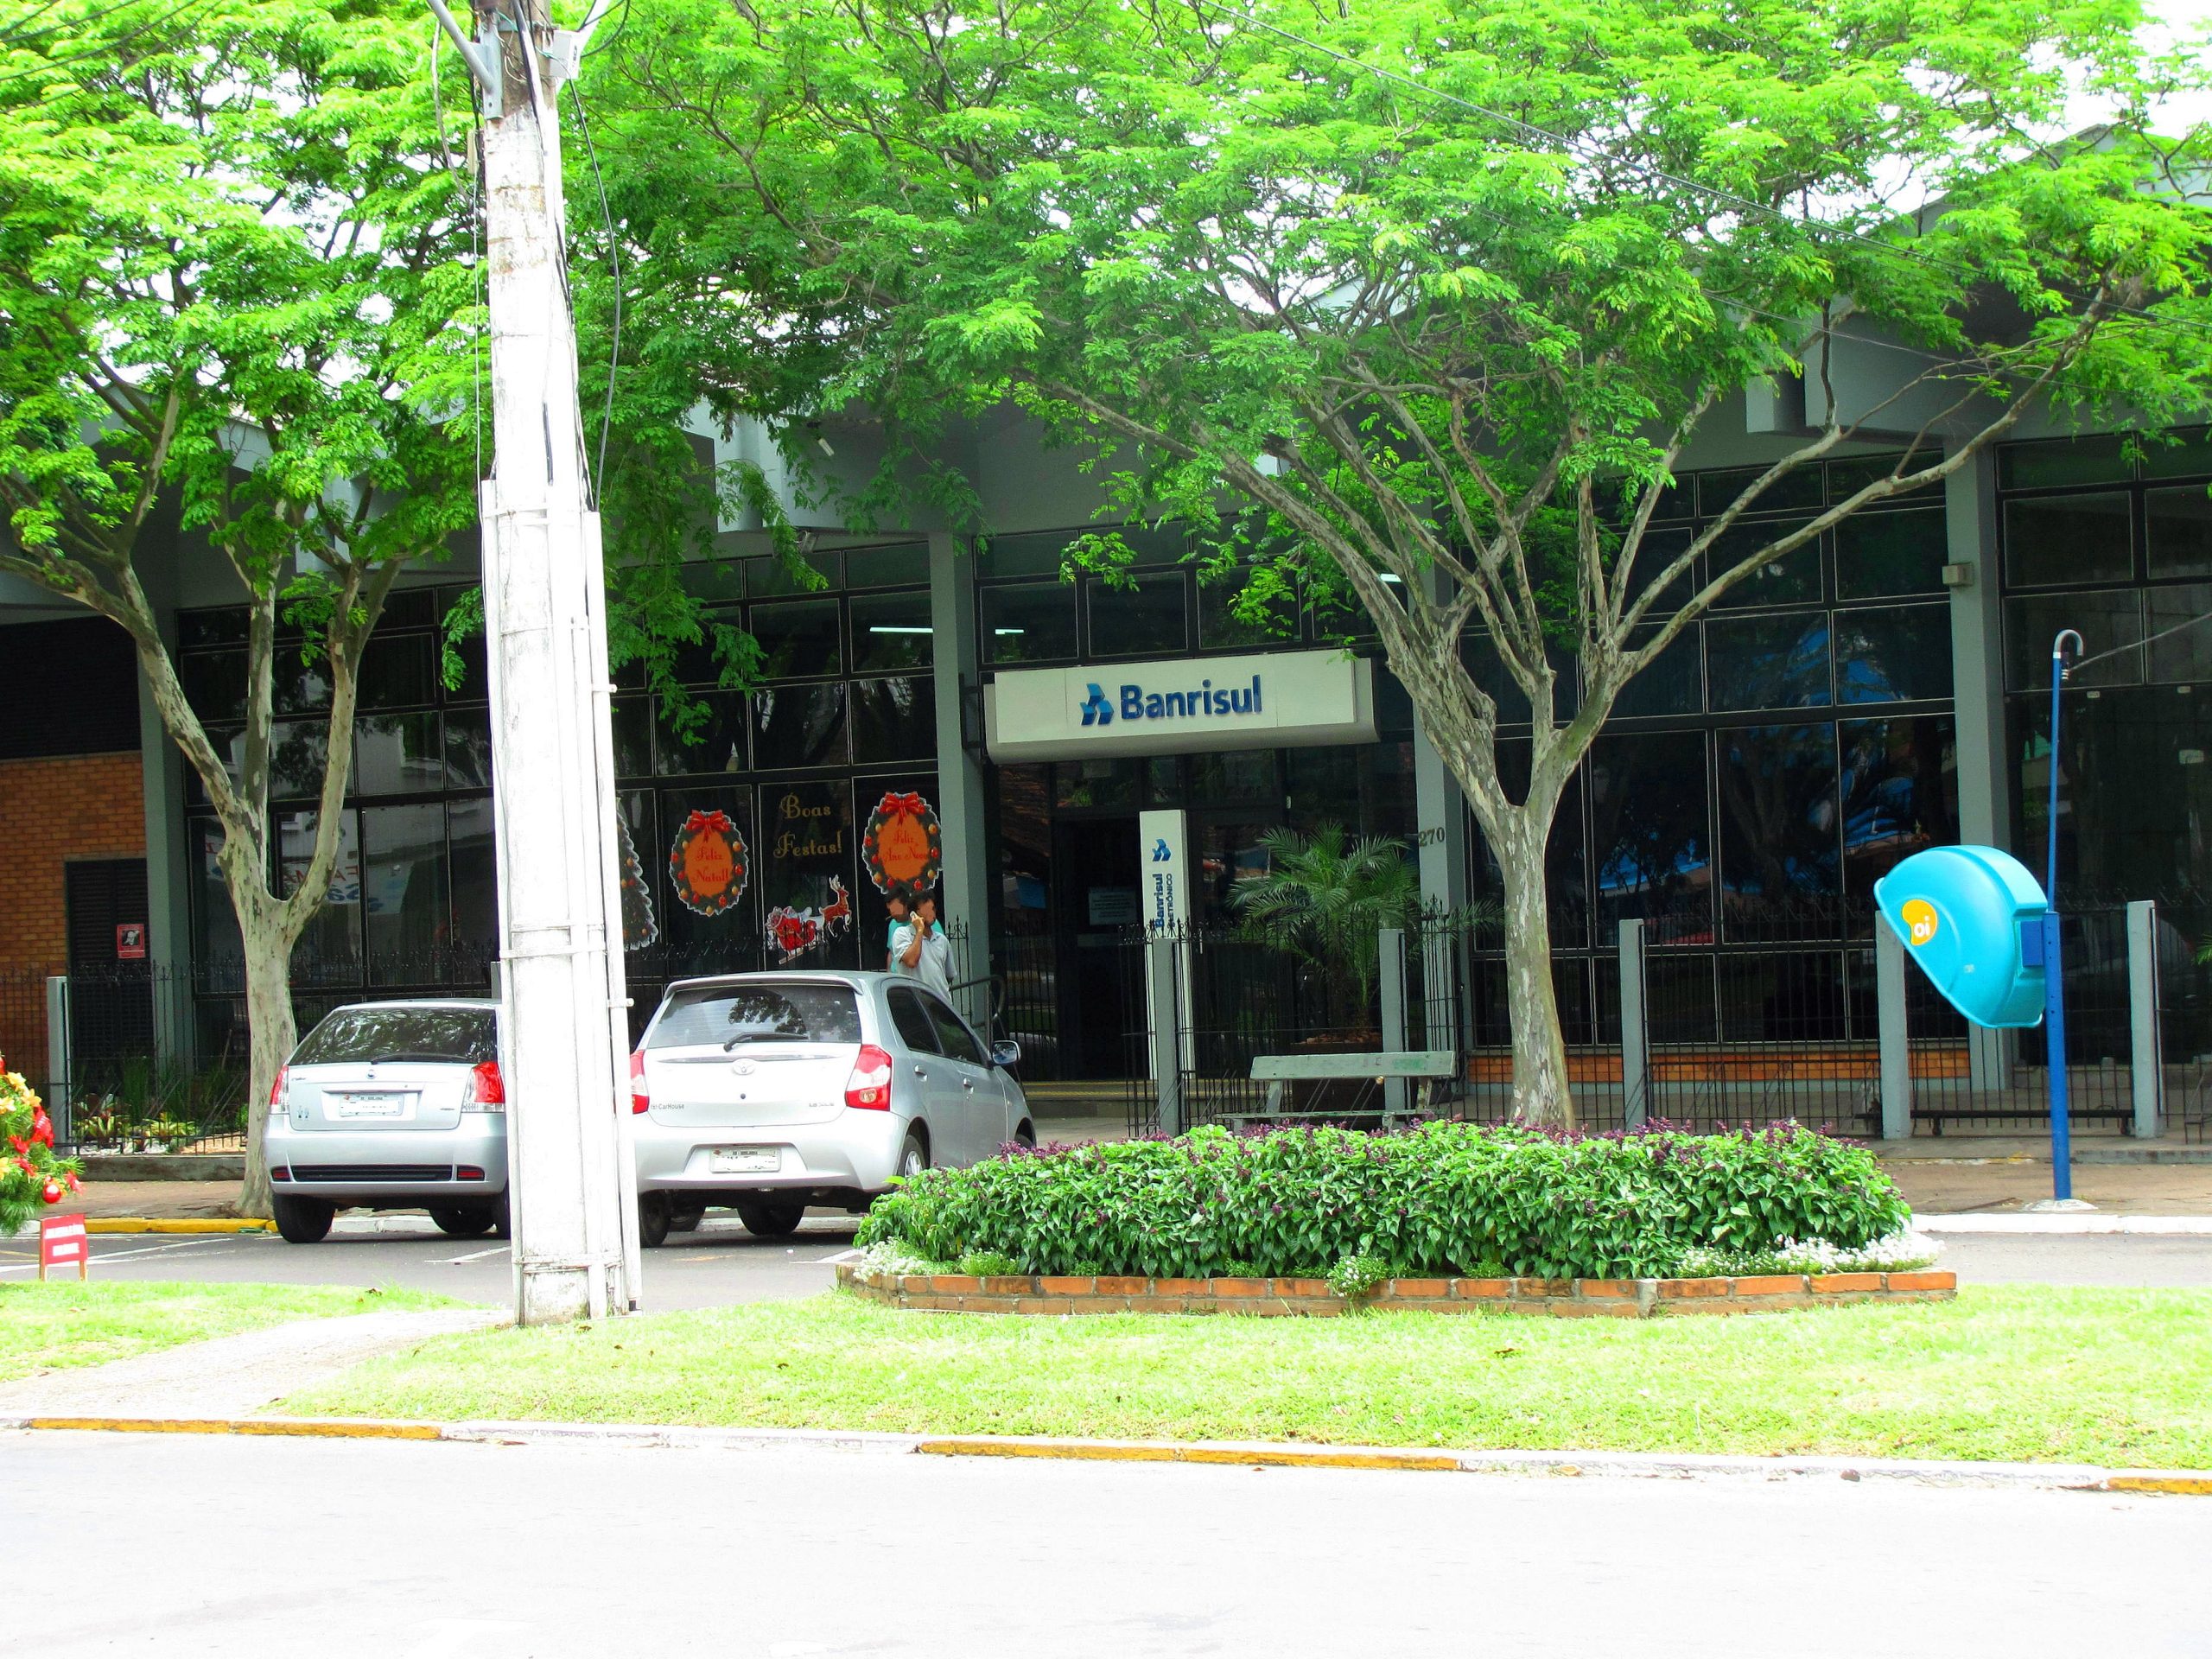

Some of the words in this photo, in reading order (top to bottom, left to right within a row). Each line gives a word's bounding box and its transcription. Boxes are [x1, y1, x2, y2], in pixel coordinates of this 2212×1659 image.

[1120, 674, 1262, 720] Banrisul
[779, 791, 831, 819] Boas
[773, 830, 842, 858] Festas!
[1419, 827, 1446, 847] 270
[694, 846, 724, 861] Feliz
[1152, 873, 1165, 928] Banrisul
[1913, 915, 1931, 938] oi
